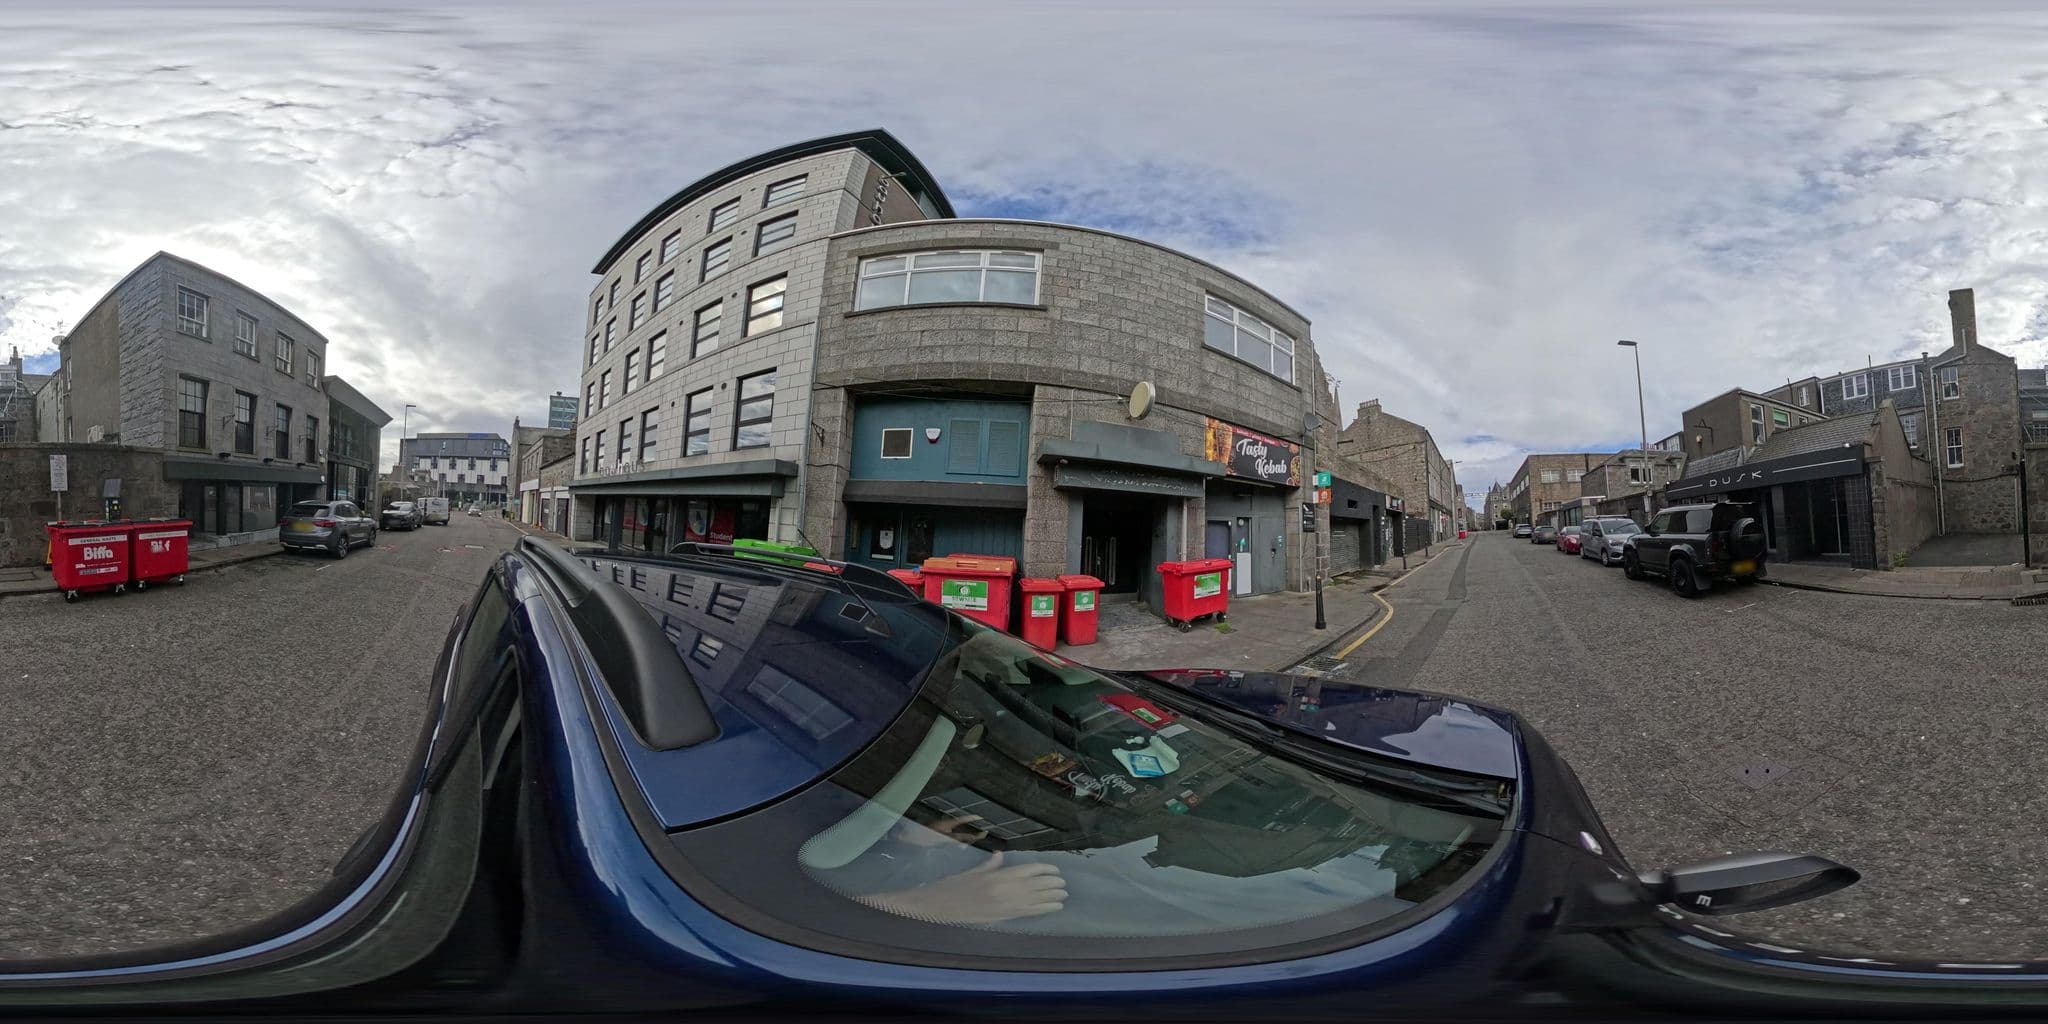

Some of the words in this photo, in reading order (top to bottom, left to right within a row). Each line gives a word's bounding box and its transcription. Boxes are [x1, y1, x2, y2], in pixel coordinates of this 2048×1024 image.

[1236, 438, 1267, 460] Tasty
[1255, 457, 1287, 479] Kebab
[1709, 470, 1762, 487] DUSK
[83, 545, 113, 561] Biffa
